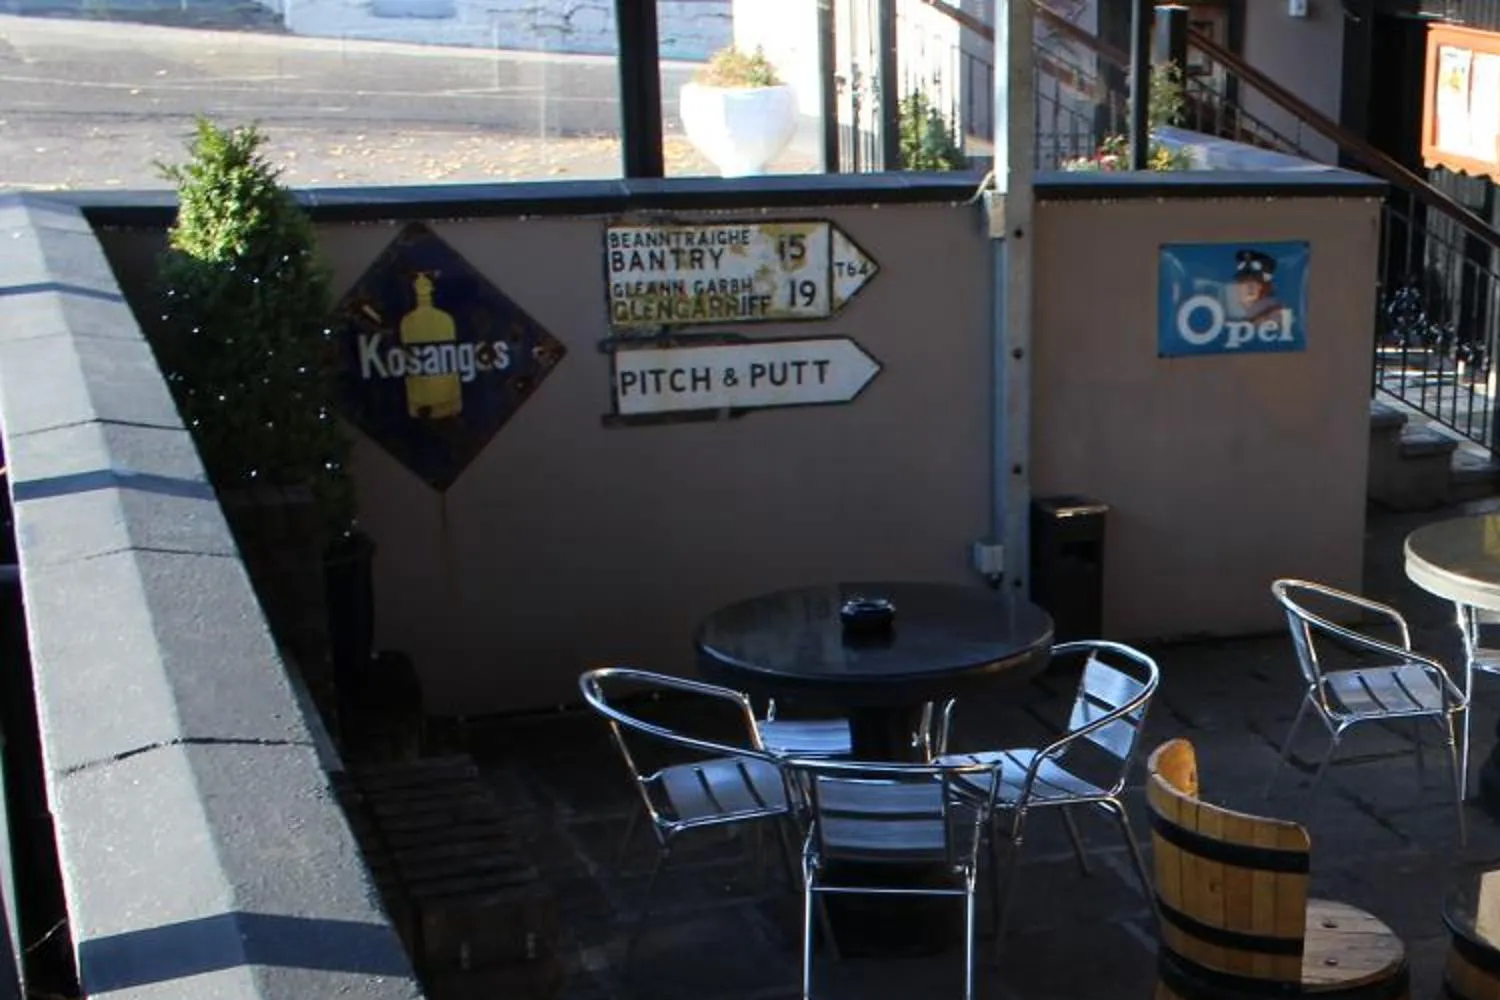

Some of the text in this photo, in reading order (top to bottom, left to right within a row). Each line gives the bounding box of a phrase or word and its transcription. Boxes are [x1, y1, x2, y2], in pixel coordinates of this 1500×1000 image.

[608, 229, 750, 249] BEANNTRAIGHE
[778, 233, 806, 261] 15
[611, 247, 725, 273] BANTRY
[693, 277, 753, 296] GARBH
[788, 280, 816, 308] 19
[1178, 295, 1295, 349] Opel
[619, 359, 830, 397] PITCH & PUTT
